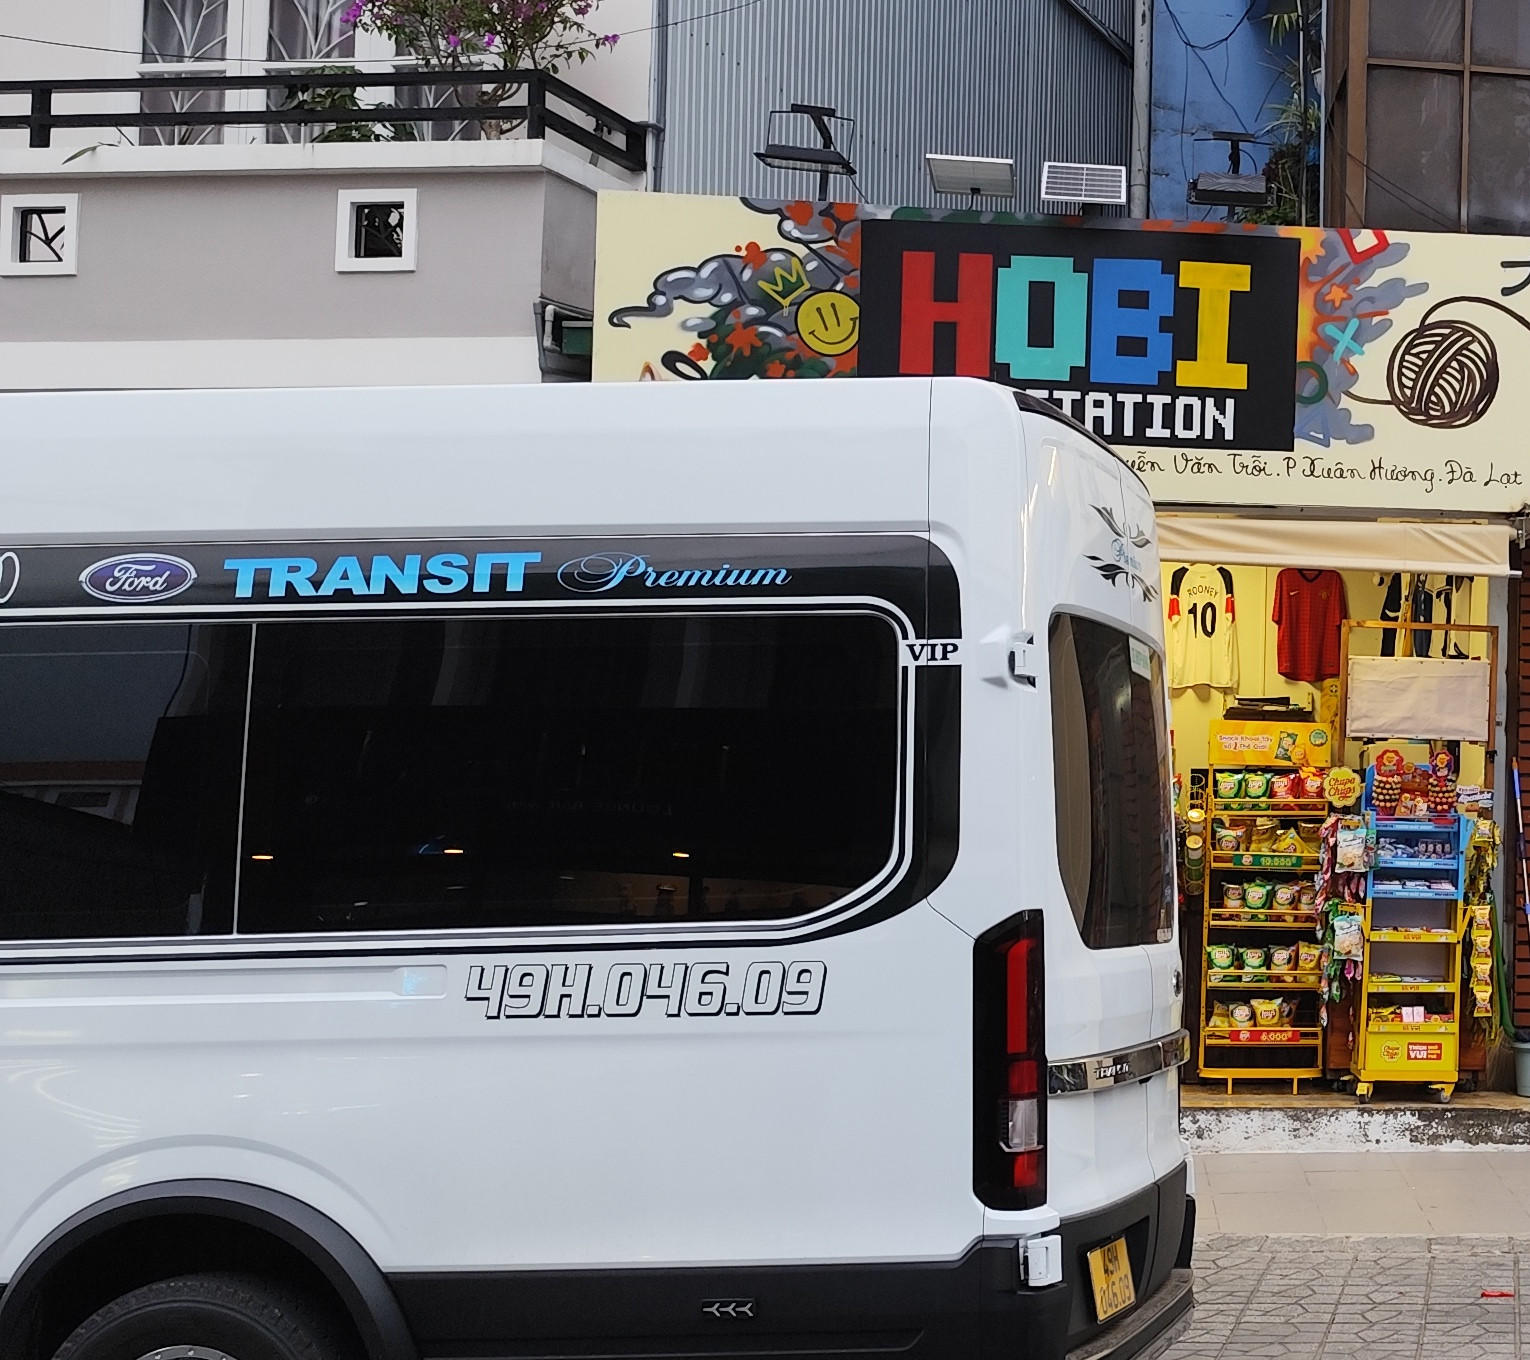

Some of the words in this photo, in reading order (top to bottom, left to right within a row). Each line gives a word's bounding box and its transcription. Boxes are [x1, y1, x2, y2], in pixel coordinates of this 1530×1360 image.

[900, 251, 1251, 389] HOBI
[1026, 390, 1235, 440] TATION
[1174, 452, 1222, 475] Văn
[1302, 456, 1366, 480] Xuân
[1483, 462, 1524, 489] Lạt
[105, 563, 171, 592] Ford
[223, 551, 542, 599] TRANSIT
[557, 551, 792, 593] Premium
[1186, 584, 1219, 599] ROONEY
[1187, 601, 1218, 639] 10
[906, 642, 960, 662] VIP
[1328, 776, 1356, 789] Chupa
[1328, 786, 1356, 801] Chups
[464, 960, 828, 1019] 49H.046.09
